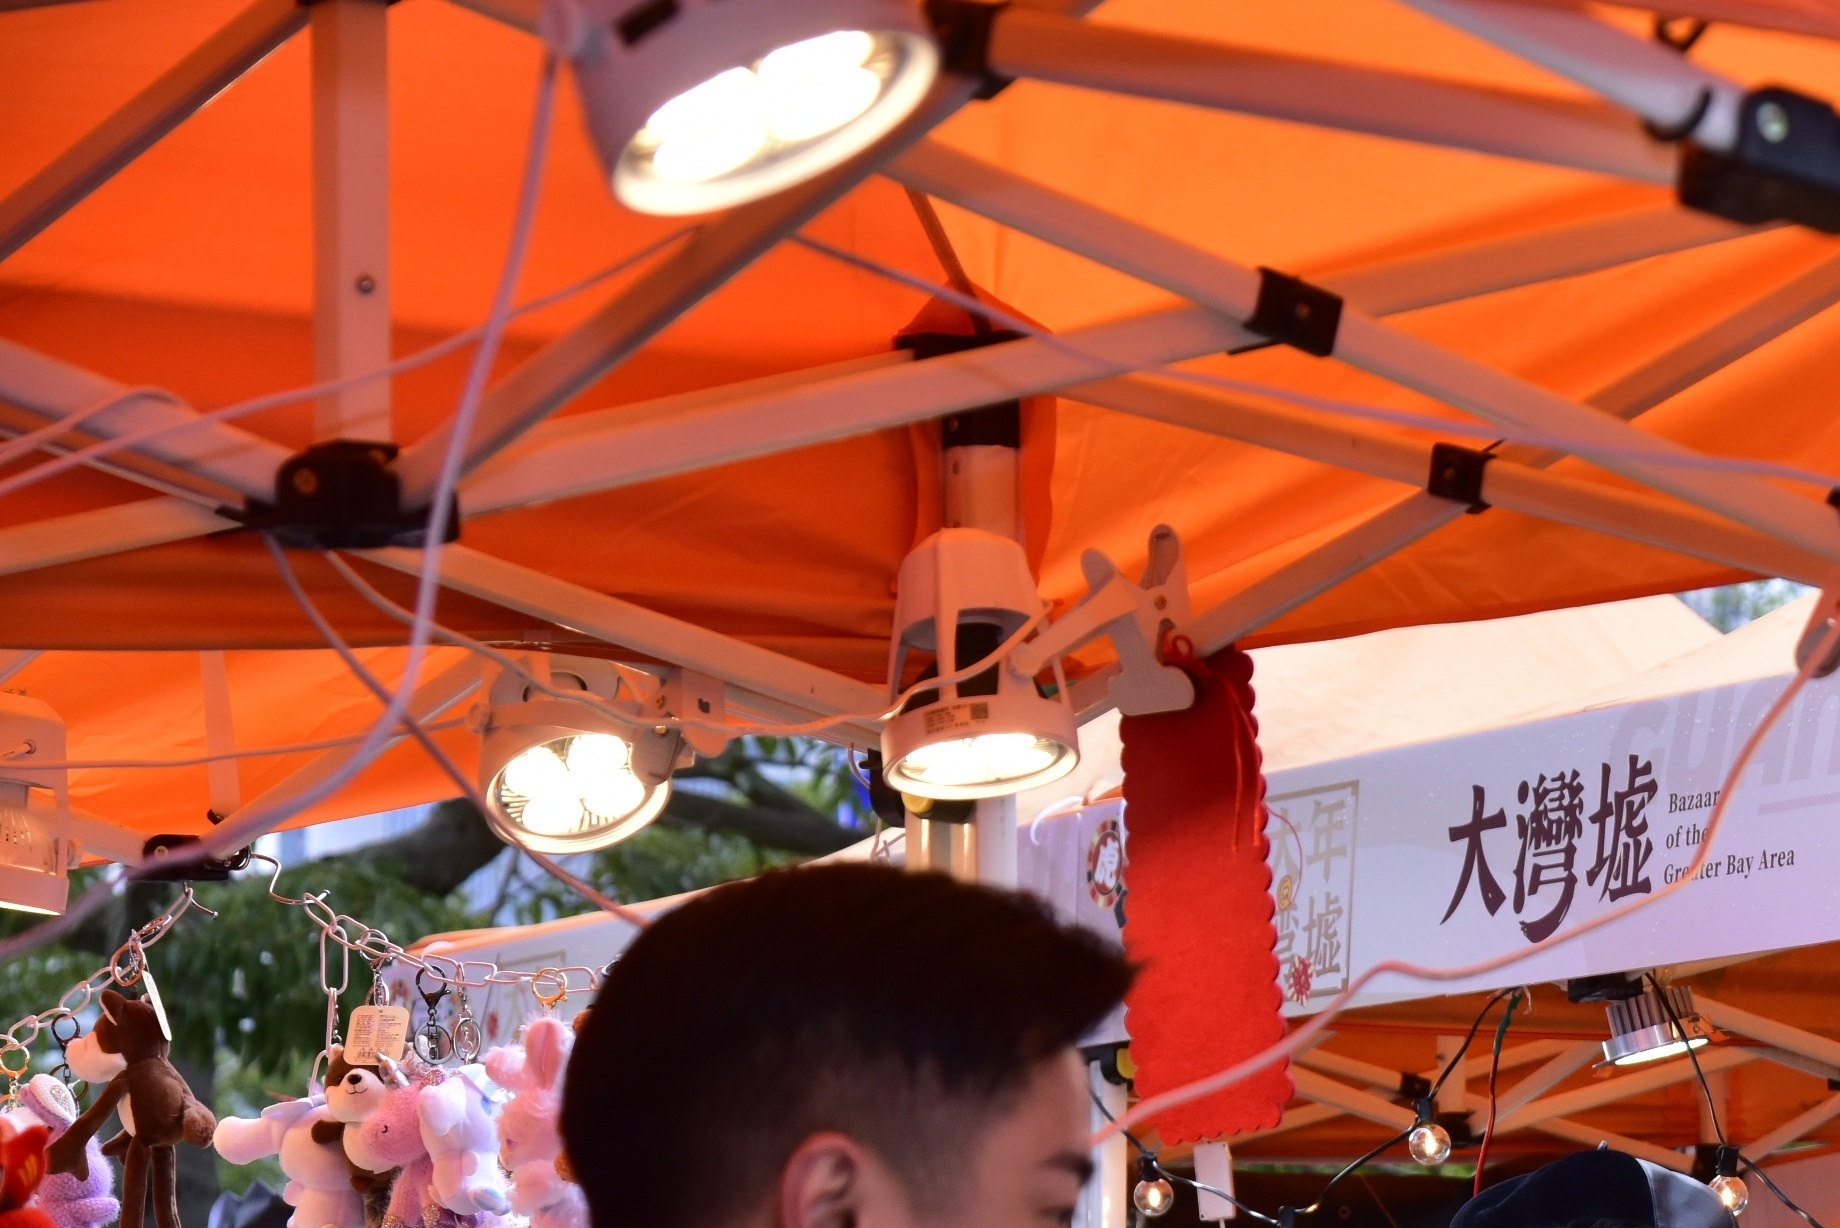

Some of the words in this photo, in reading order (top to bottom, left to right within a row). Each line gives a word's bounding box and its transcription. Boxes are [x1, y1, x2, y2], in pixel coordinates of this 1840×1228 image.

[1668, 788, 1721, 815] Bazaar
[1440, 754, 1658, 943] 大灣墟
[1666, 825, 1683, 850] of
[1685, 823, 1708, 847] the
[1726, 854, 1752, 880] Bay
[1758, 848, 1795, 872] Area
